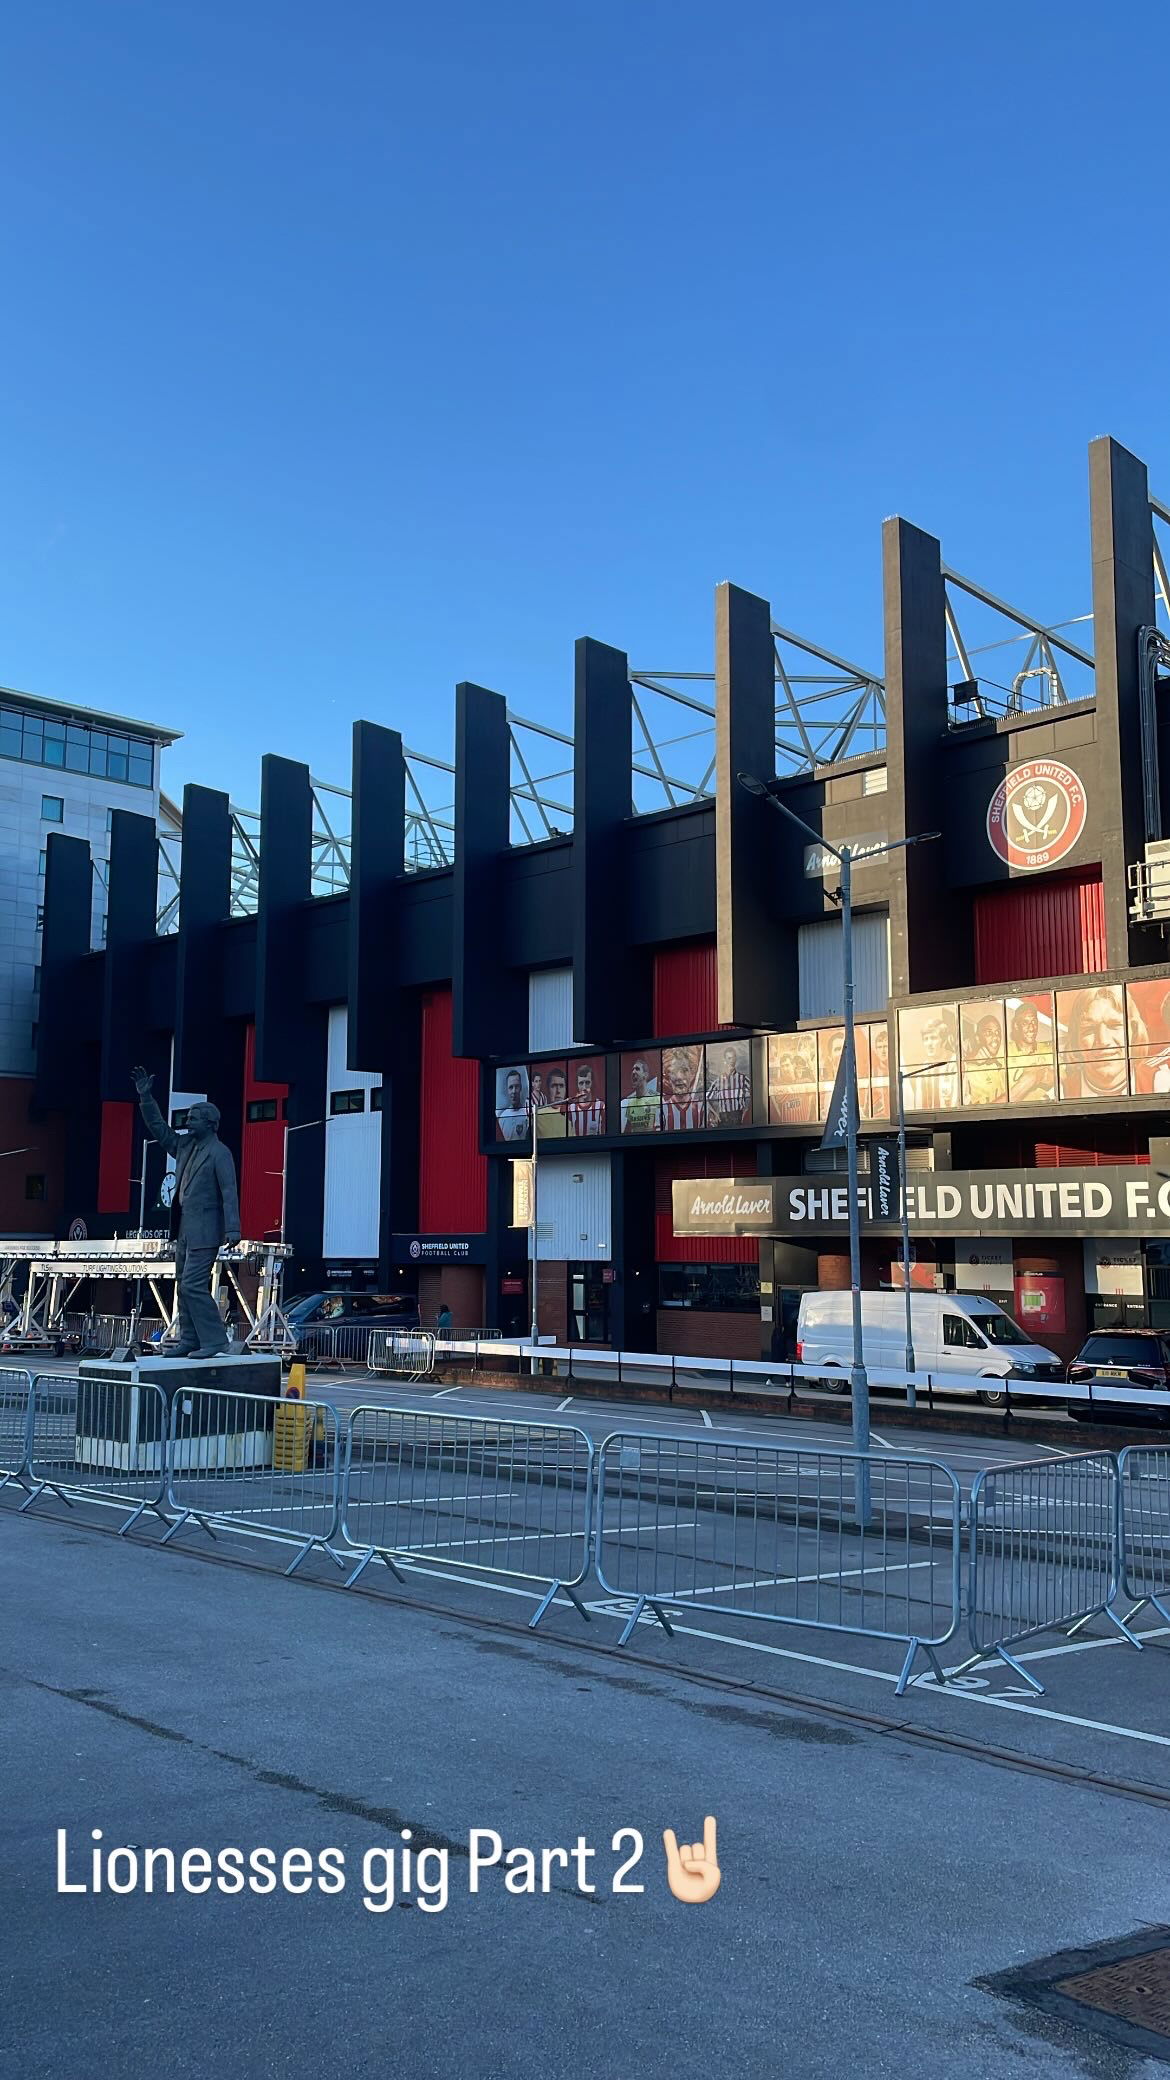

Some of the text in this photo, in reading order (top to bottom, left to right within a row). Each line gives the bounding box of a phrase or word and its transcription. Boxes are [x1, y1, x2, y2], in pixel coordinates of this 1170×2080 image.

[991, 768, 1031, 823] SHEFFIELD
[1034, 764, 1072, 786] UNITED
[806, 843, 851, 871] Arnol
[1026, 851, 1050, 864] 1889
[834, 1087, 848, 1137] aver
[877, 1146, 891, 1216] Arnold Laver
[691, 1194, 770, 1215] Arnold Laver
[789, 1185, 962, 1220] SHEELD
[969, 1182, 1113, 1219] UNITED
[153, 1230, 163, 1238] OF
